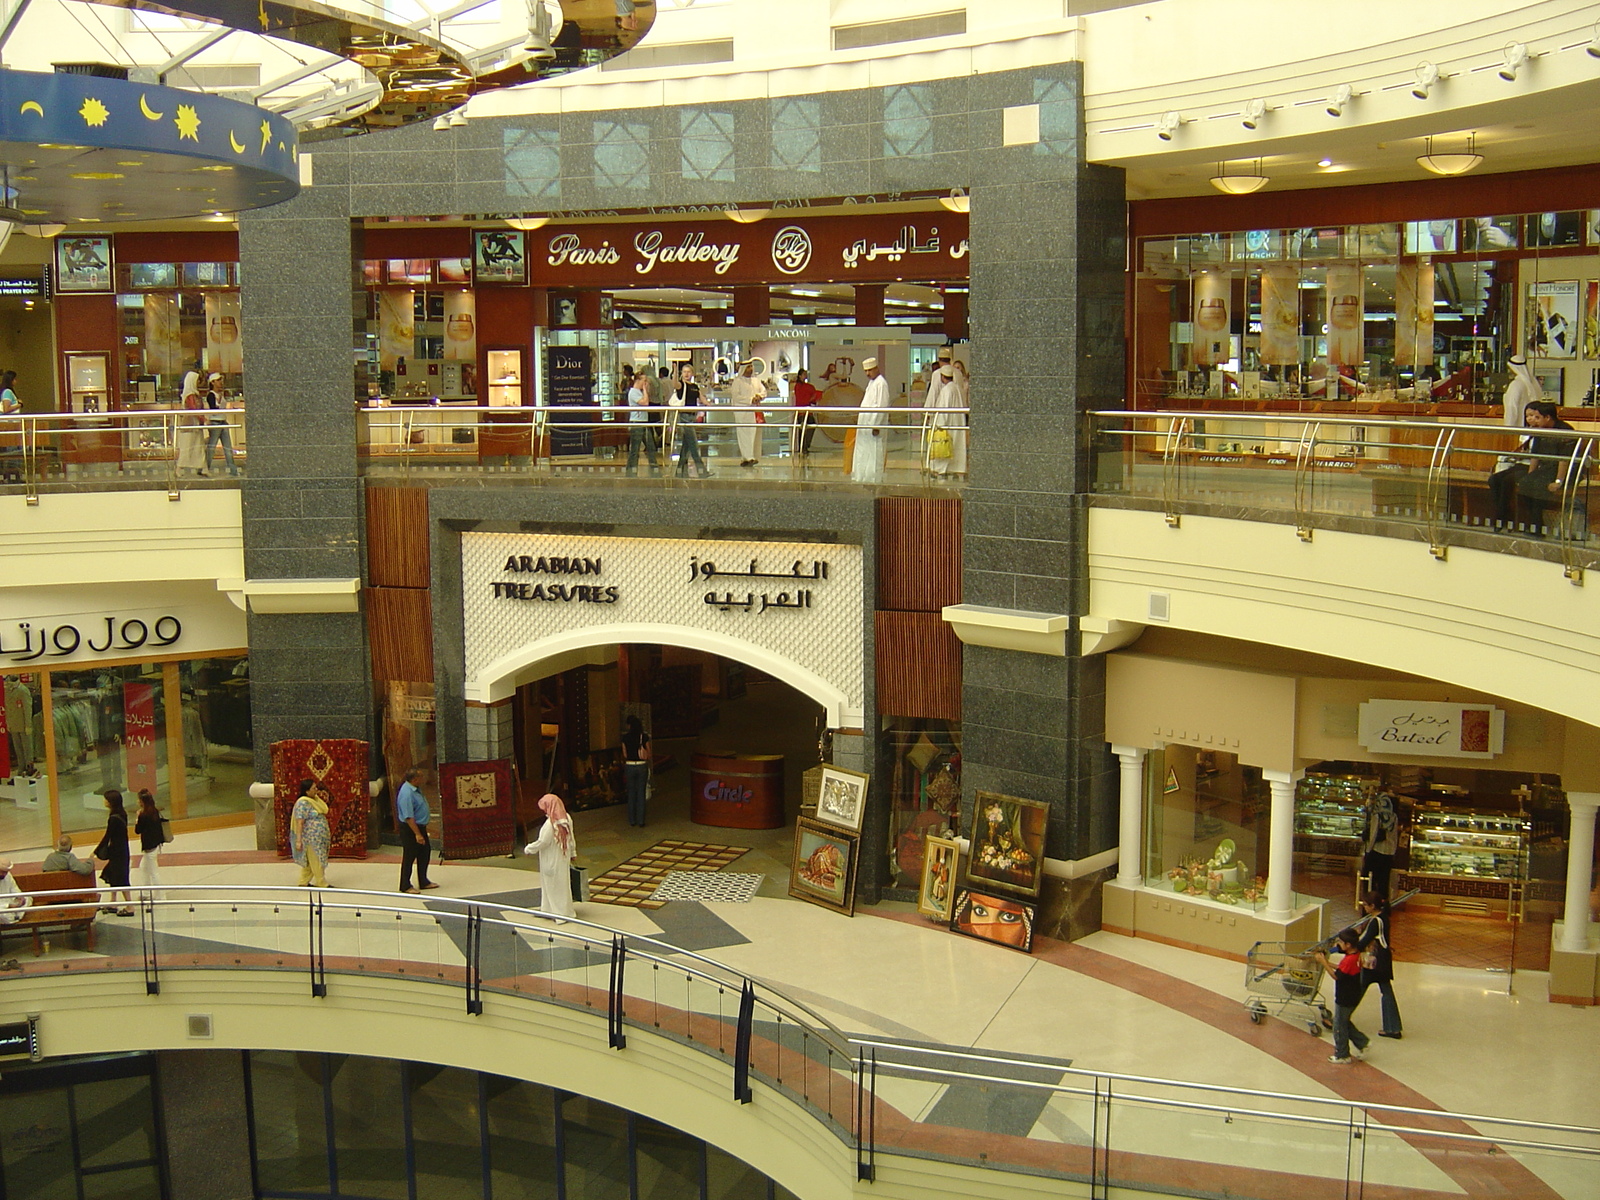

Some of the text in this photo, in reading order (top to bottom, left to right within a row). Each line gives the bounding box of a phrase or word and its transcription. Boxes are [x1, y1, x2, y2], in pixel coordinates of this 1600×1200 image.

[547, 231, 741, 275] Paris Gallery
[842, 225, 940, 268] غاليري
[1236, 252, 1277, 260] GIVENCHY
[556, 355, 583, 369] Dior
[503, 555, 602, 575] ARABIAN
[688, 556, 829, 583] الكنوز
[490, 582, 620, 604] TREASURES
[1374, 727, 1452, 745] Bateel
[703, 779, 753, 804] Circle
